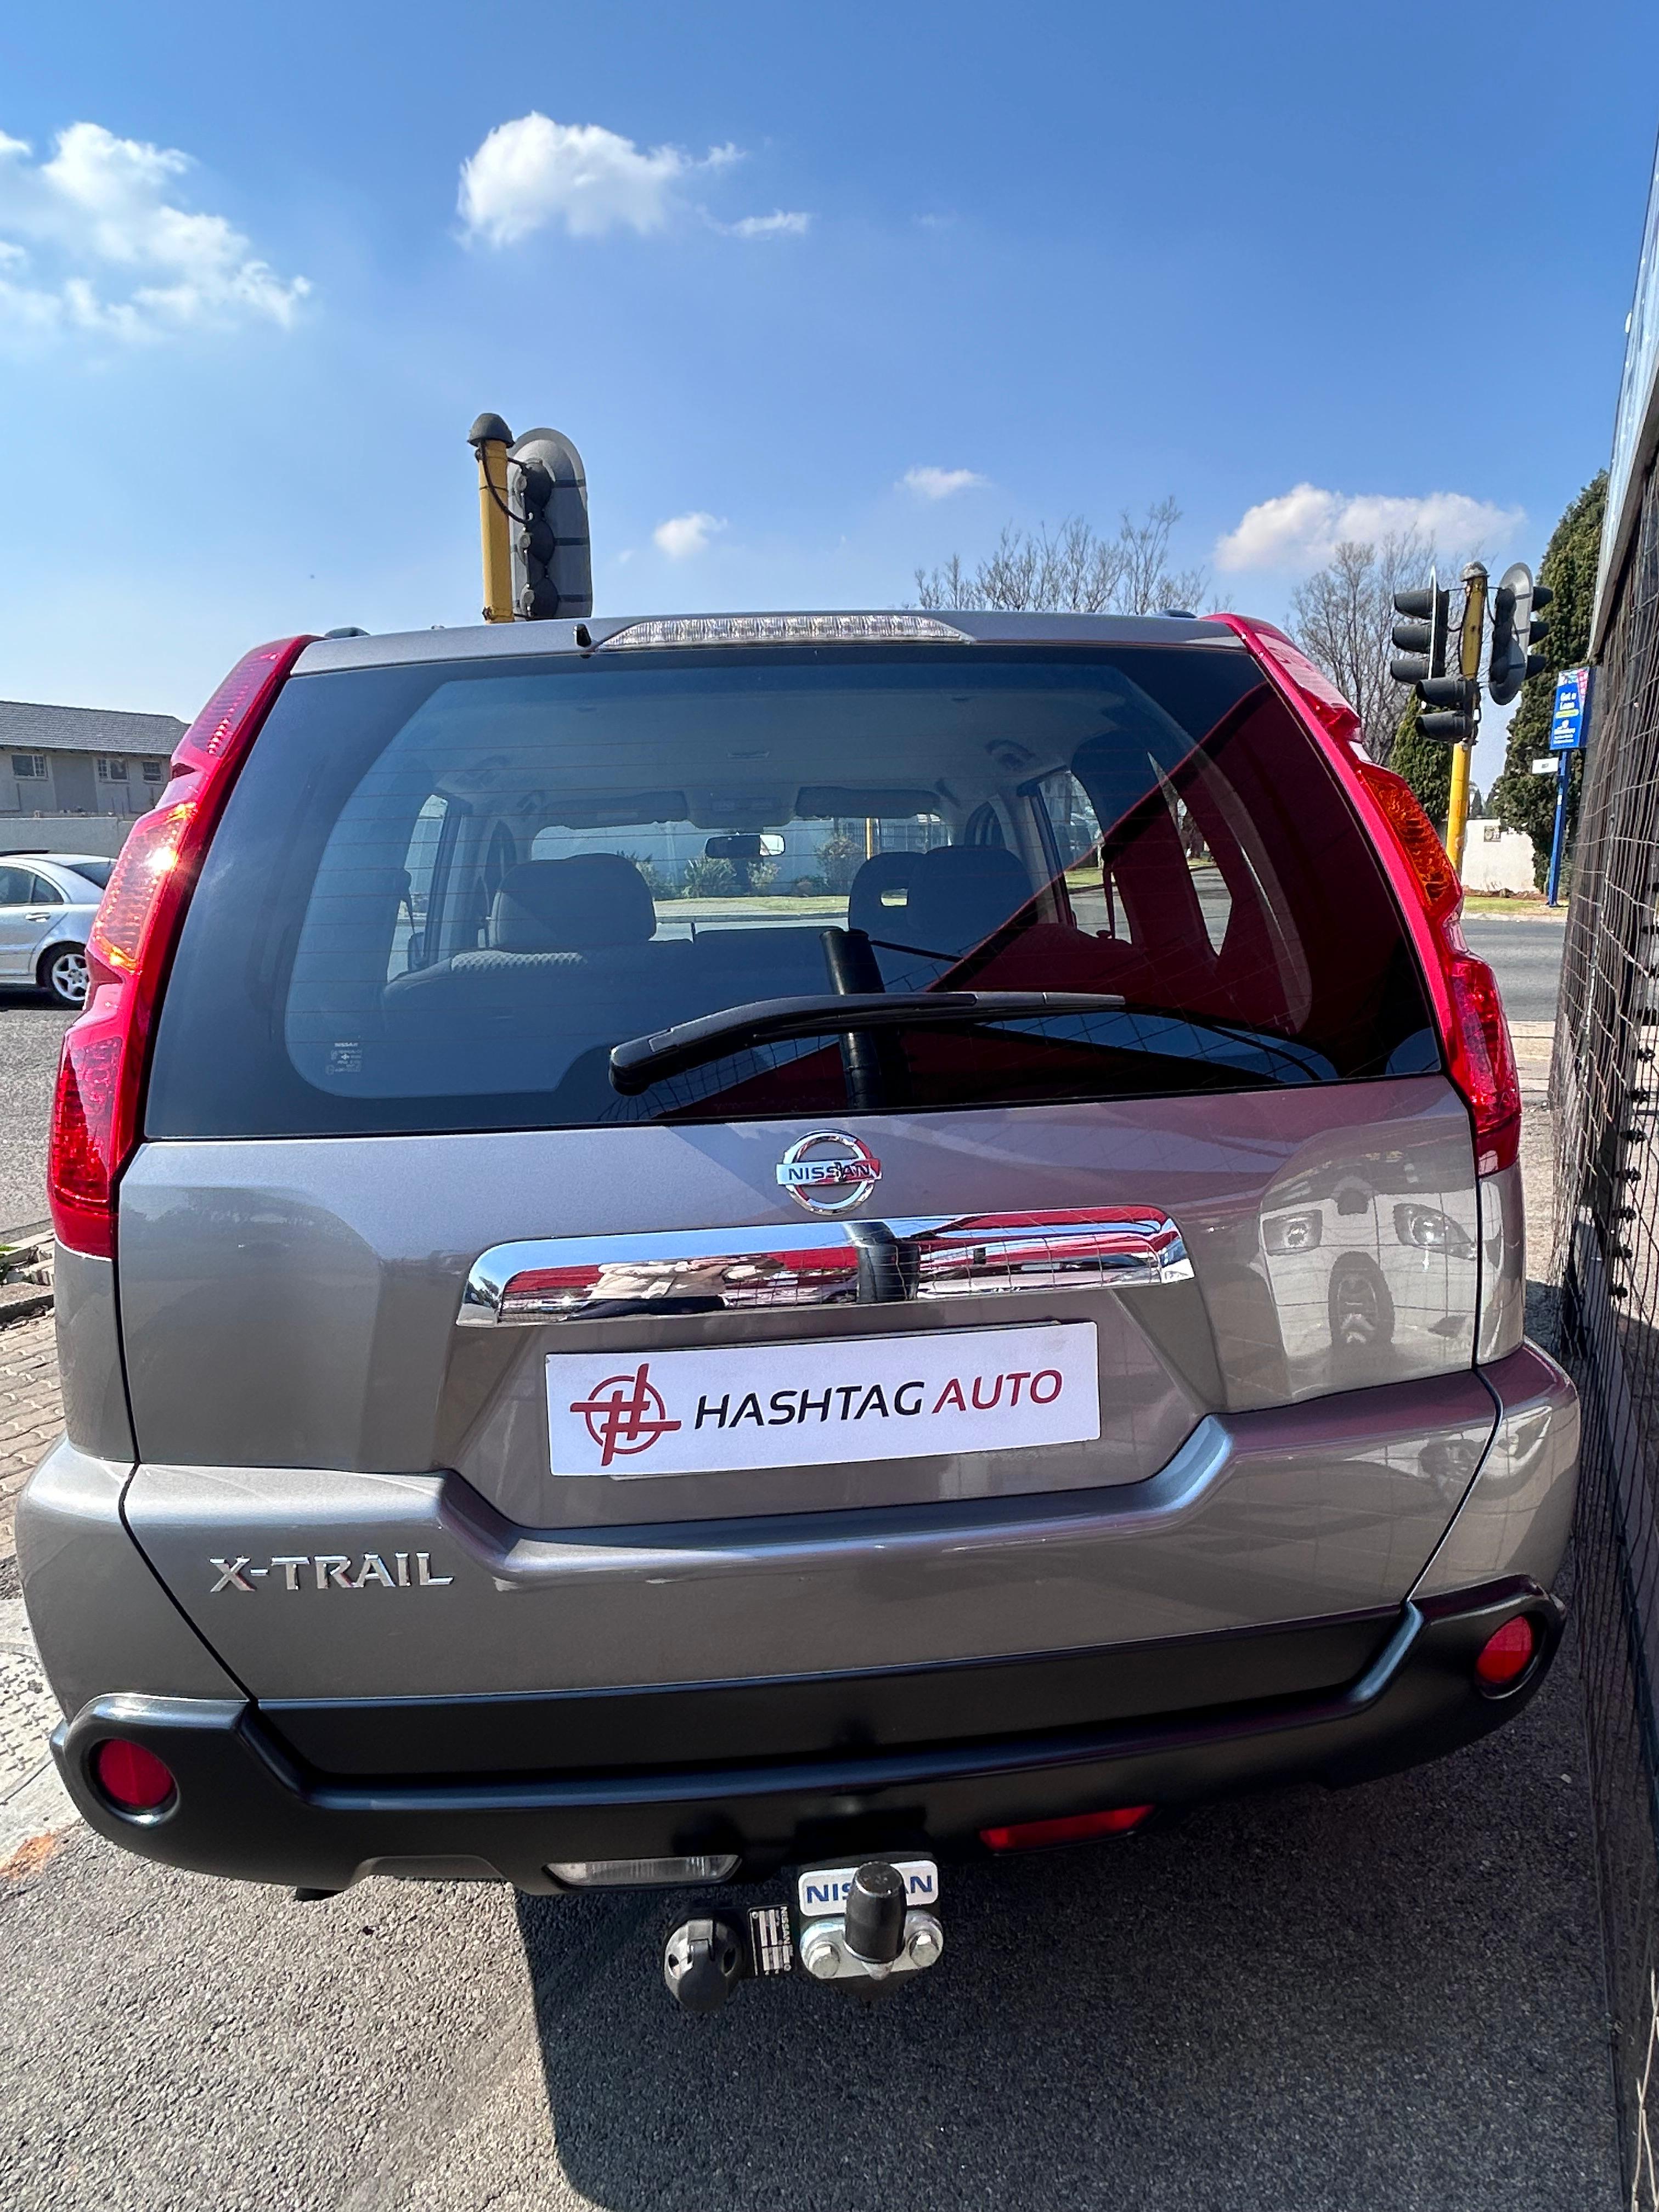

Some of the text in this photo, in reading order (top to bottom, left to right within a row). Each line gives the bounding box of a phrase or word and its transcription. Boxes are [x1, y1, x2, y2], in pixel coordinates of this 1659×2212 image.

[788, 1164, 871, 1181] NISSAN
[695, 1369, 1062, 1430] HASHTAG AUTO
[209, 1552, 454, 1593] X-TRAIL
[806, 1875, 933, 1904] NIN
